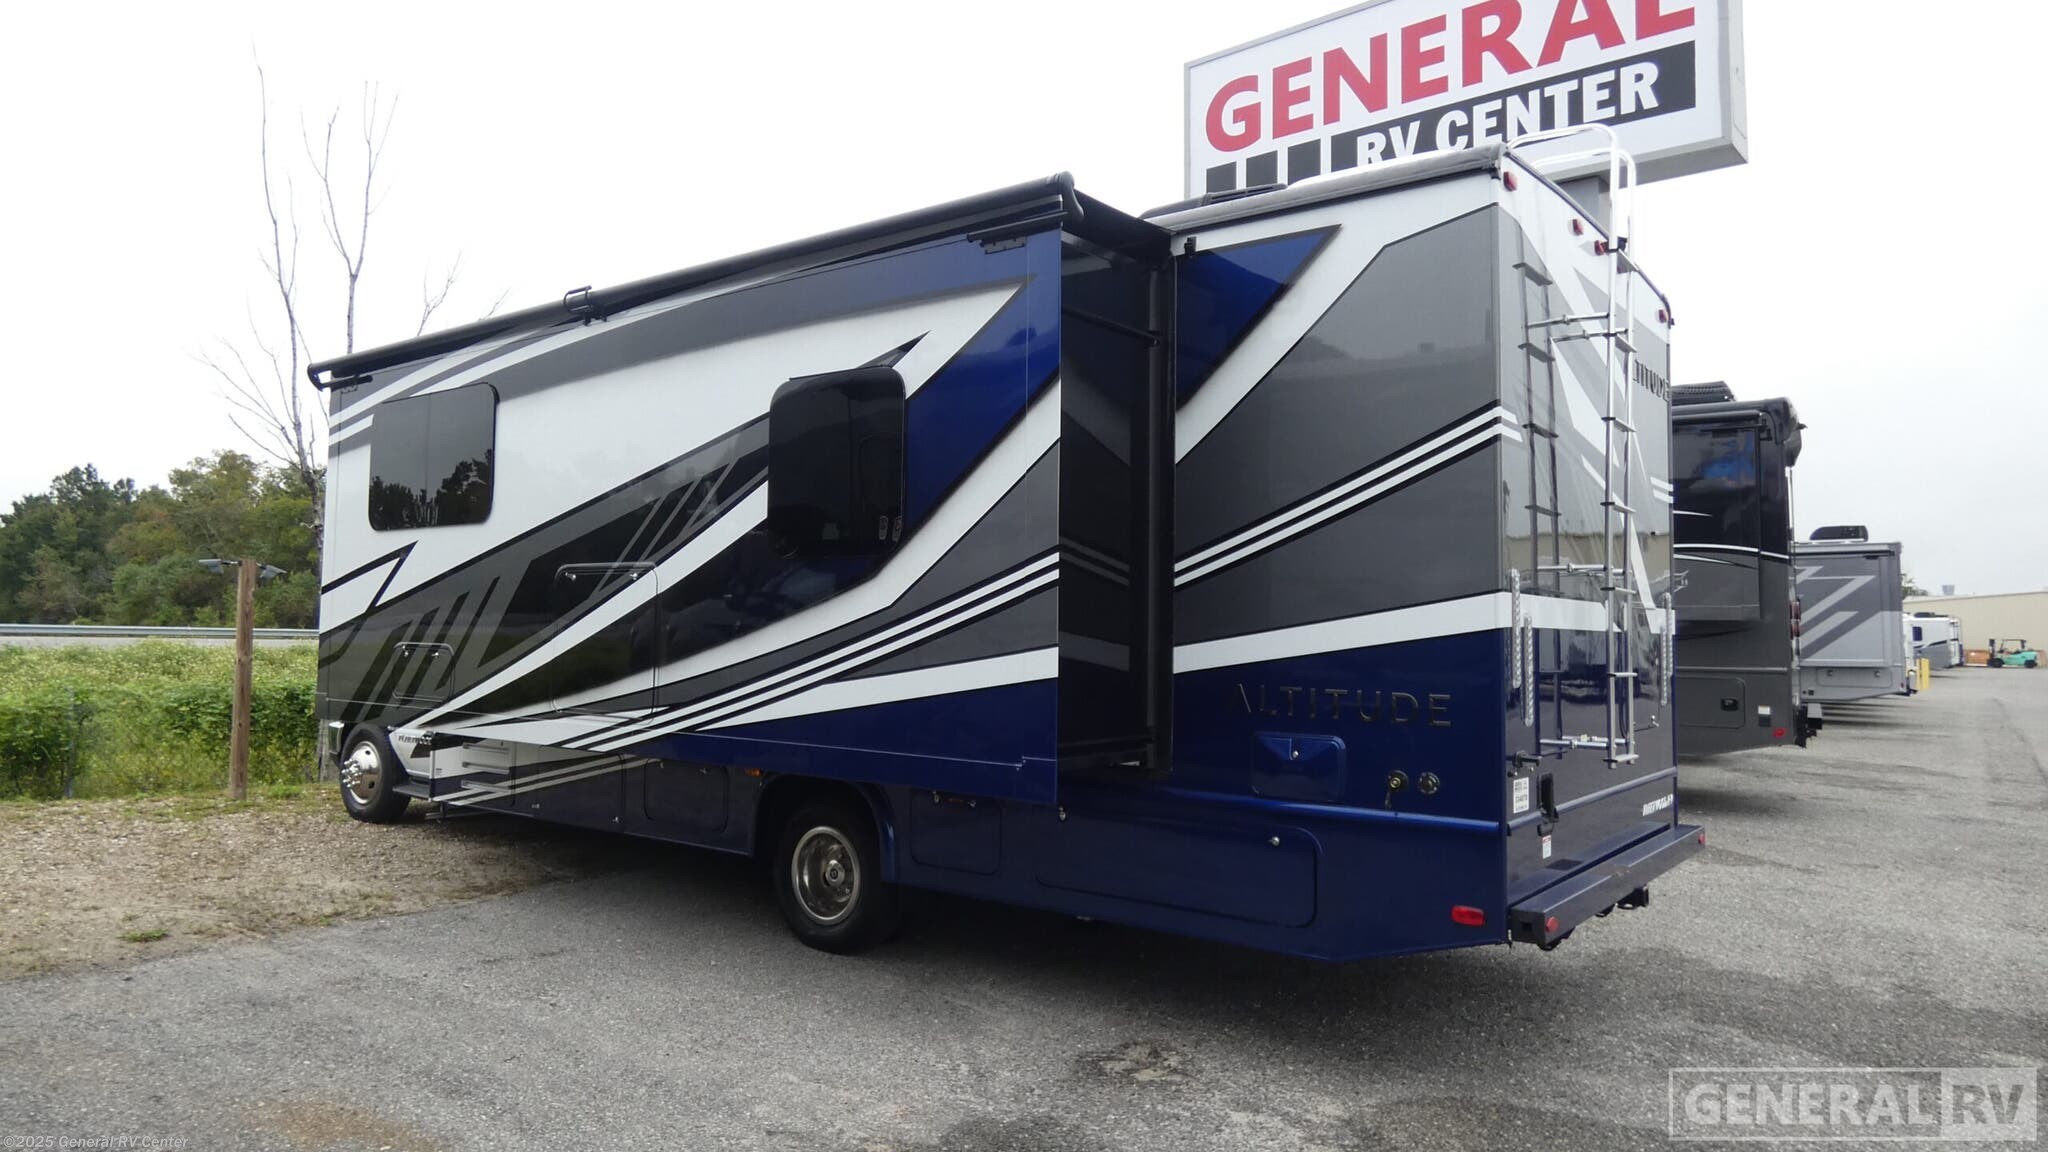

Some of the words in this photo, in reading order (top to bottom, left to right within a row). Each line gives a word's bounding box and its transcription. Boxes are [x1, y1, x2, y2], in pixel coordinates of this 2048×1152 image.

[1206, 0, 1695, 152] GENERAL
[1357, 120, 1420, 166] RV
[1436, 62, 1659, 150] CENTER
[1231, 683, 1451, 727] ALTITUDE
